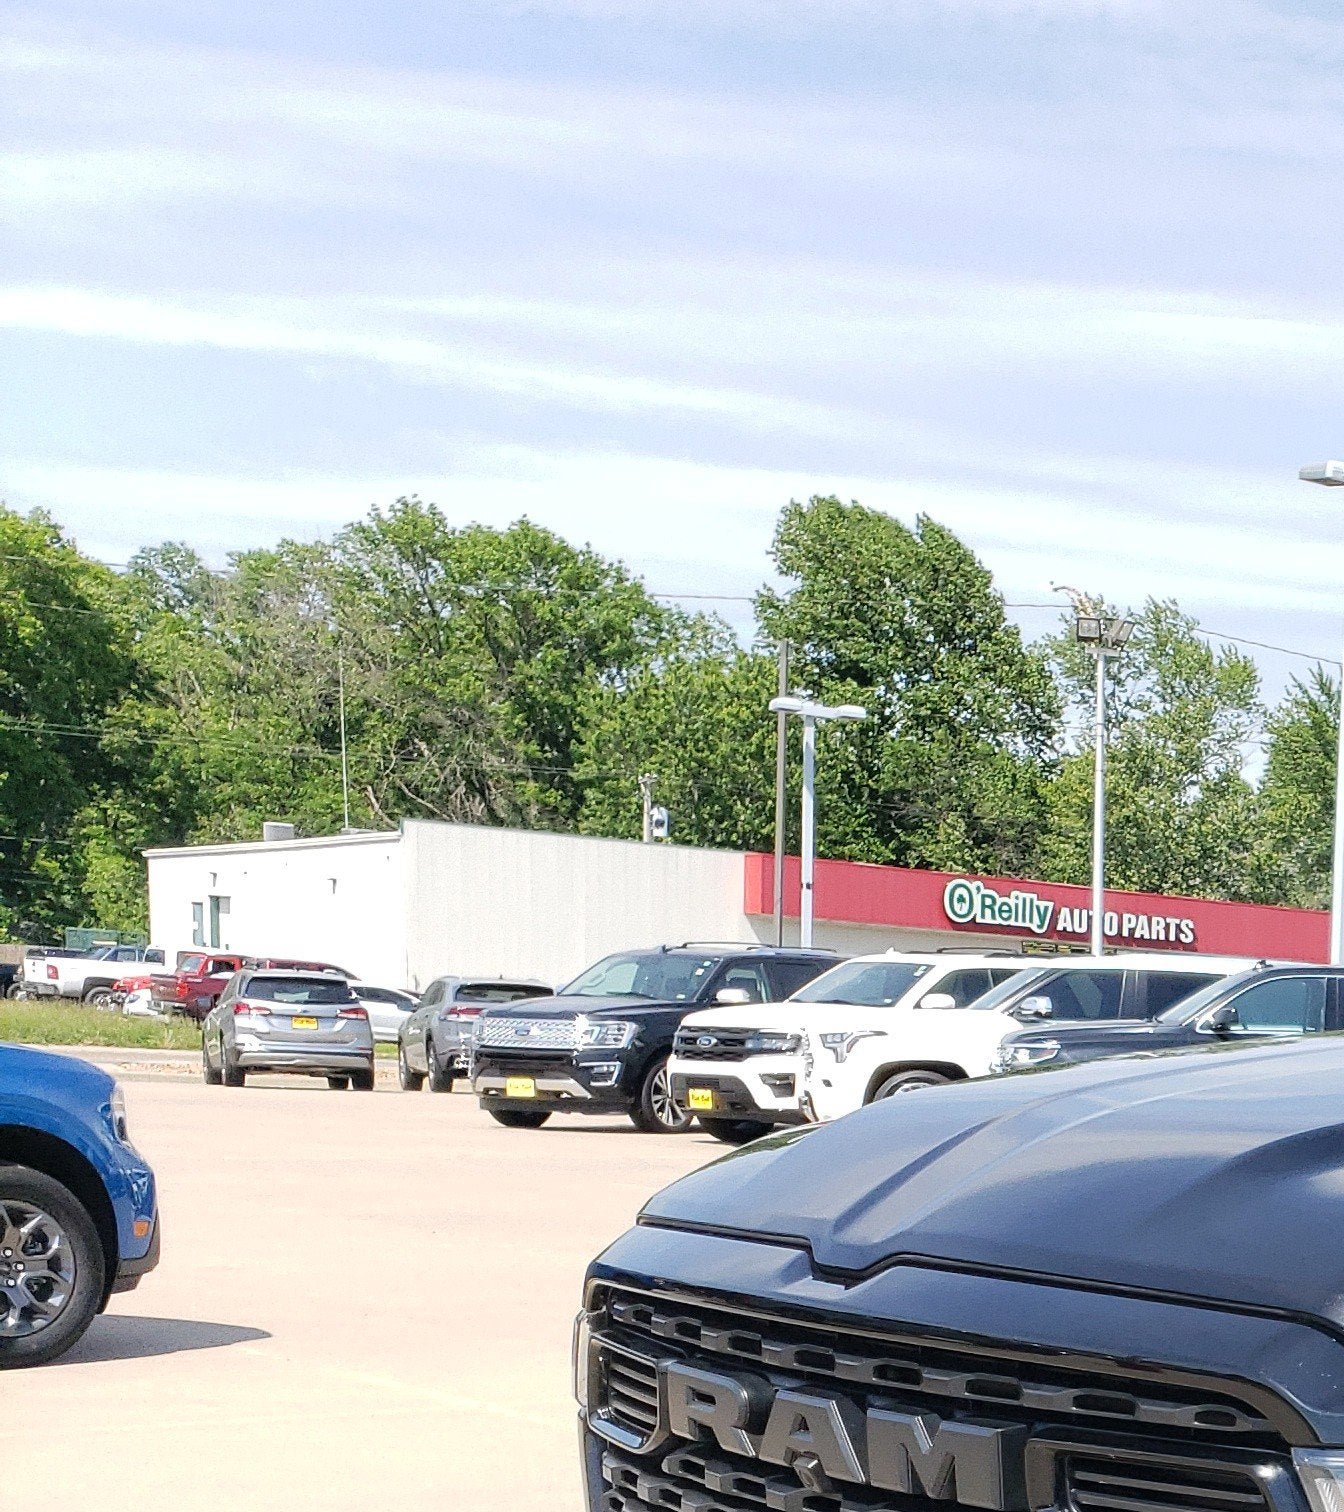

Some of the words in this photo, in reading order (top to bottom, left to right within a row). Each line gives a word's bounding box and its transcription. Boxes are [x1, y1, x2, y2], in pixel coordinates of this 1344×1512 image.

[945, 880, 1053, 931] O'Reilly
[1056, 907, 1119, 936] AUO
[1122, 913, 1195, 944] PARTS
[667, 1361, 1022, 1512] RAM
